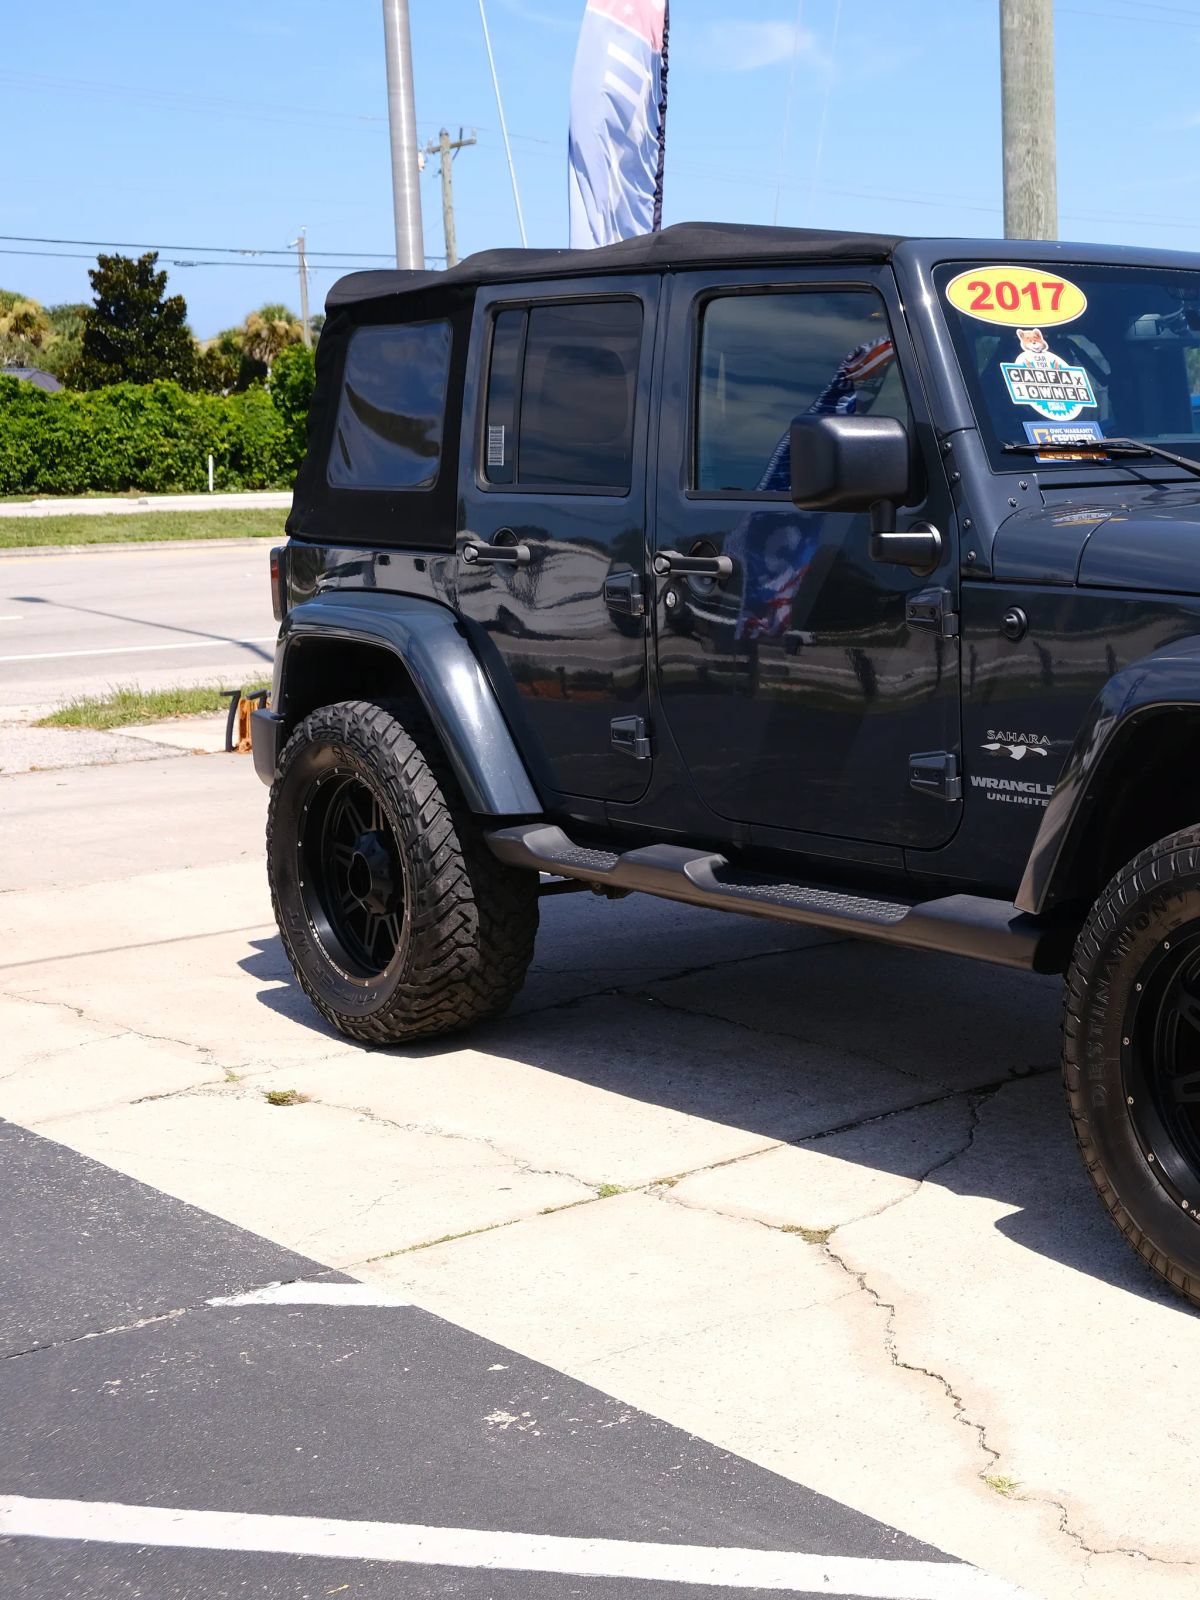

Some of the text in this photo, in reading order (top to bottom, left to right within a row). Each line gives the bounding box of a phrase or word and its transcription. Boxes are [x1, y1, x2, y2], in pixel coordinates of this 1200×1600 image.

[967, 281, 1065, 310] 2017
[1008, 369, 1083, 386] CARFAX
[1027, 386, 1088, 400] OWNER
[986, 729, 1051, 746] SAHARA
[970, 775, 1055, 795] WRANGLE
[986, 792, 1050, 807] UNLIMITE
